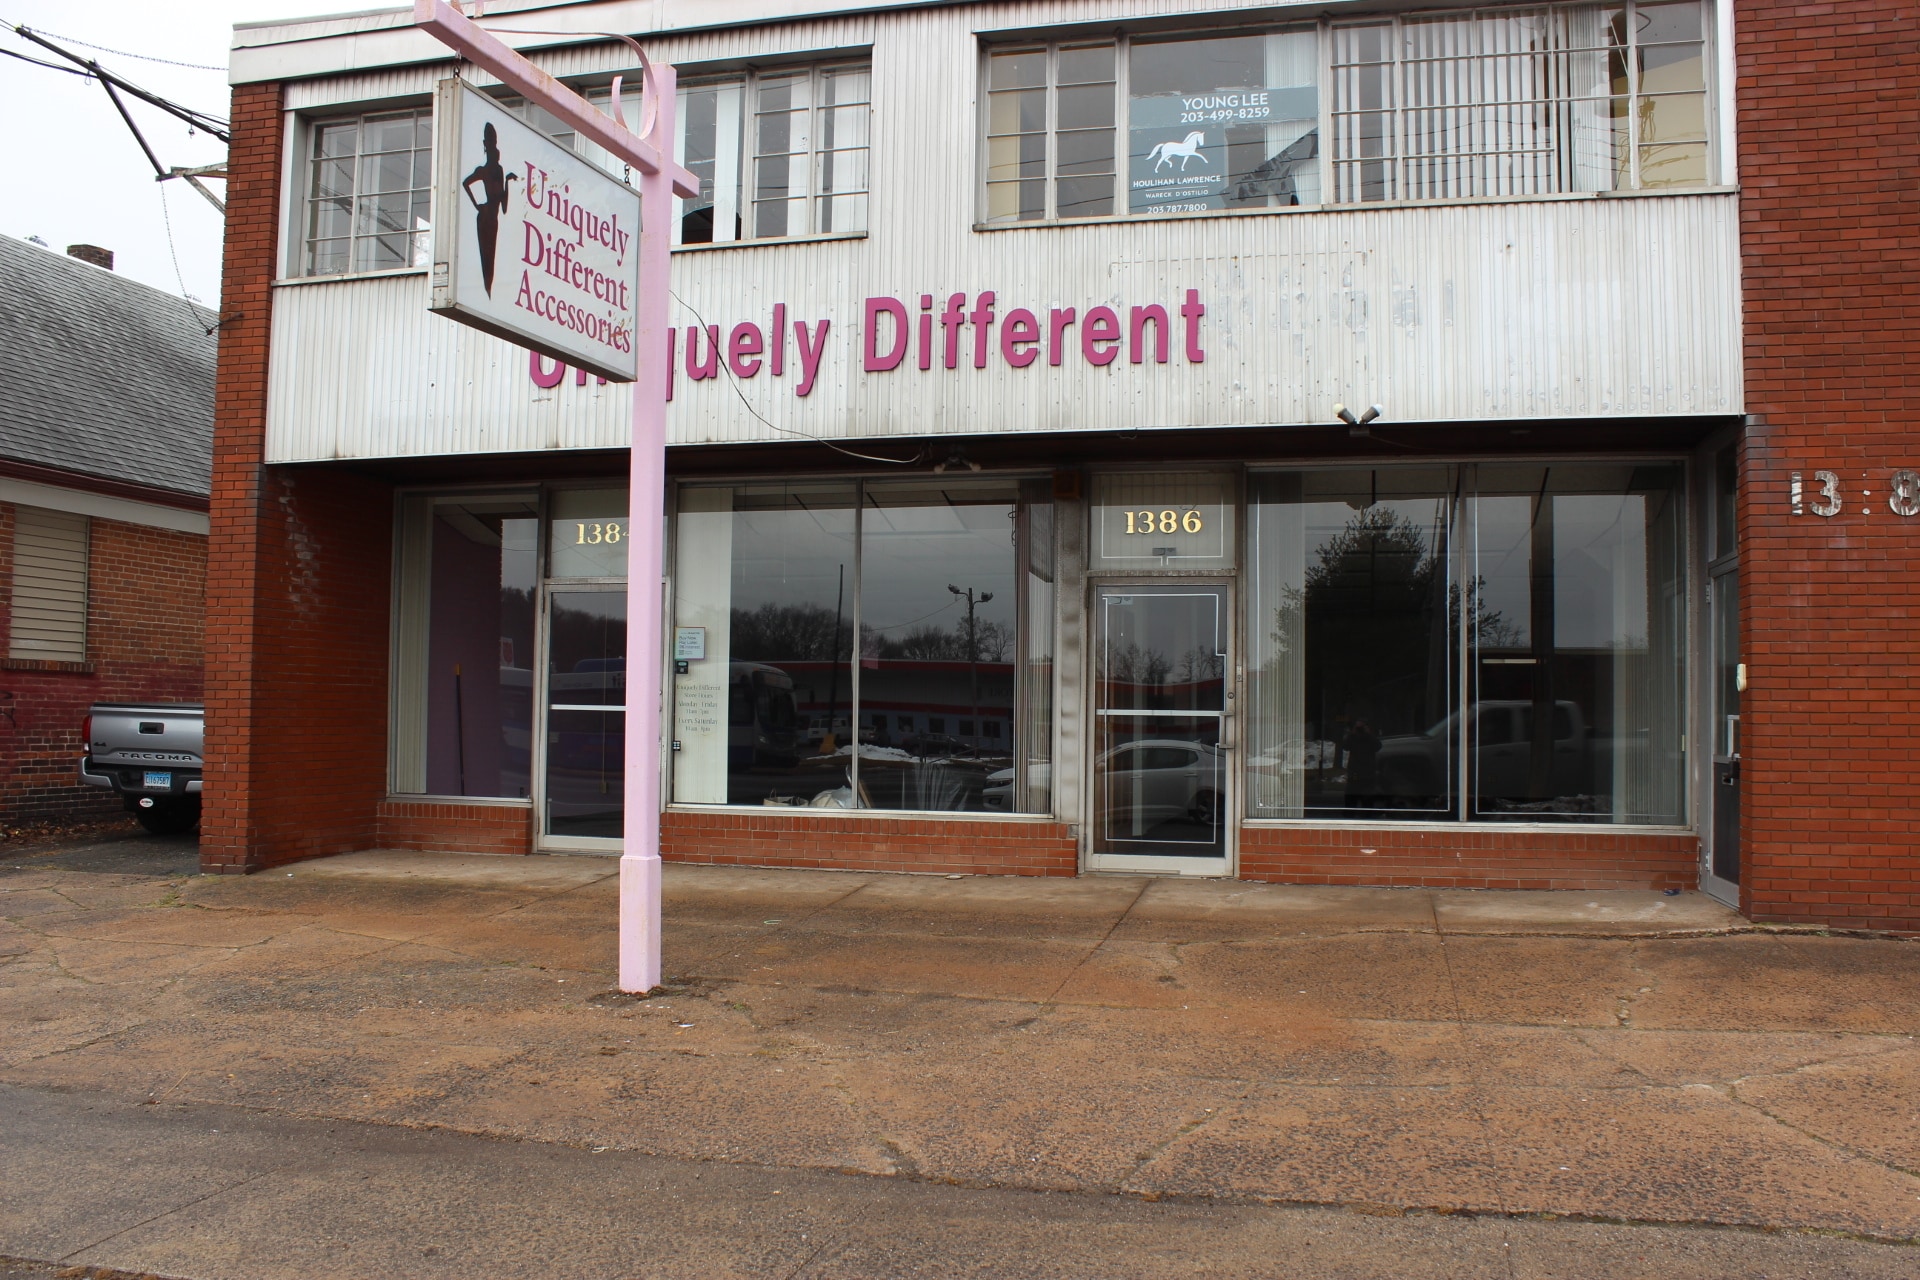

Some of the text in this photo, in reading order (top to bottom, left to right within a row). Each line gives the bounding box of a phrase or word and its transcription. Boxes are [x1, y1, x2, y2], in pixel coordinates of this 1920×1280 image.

[1182, 93, 1268, 111] YOUNG LEE
[1180, 106, 1270, 123] 203-499-8259
[1133, 175, 1221, 188] HOULIHAN LAWRENCE
[524, 161, 630, 267] Uniquely
[521, 219, 628, 311] Different
[514, 268, 631, 354] Accessories
[863, 289, 1205, 373] Different
[575, 522, 630, 545] 138
[1123, 510, 1202, 534] 1386
[119, 752, 192, 761] TACOMA
